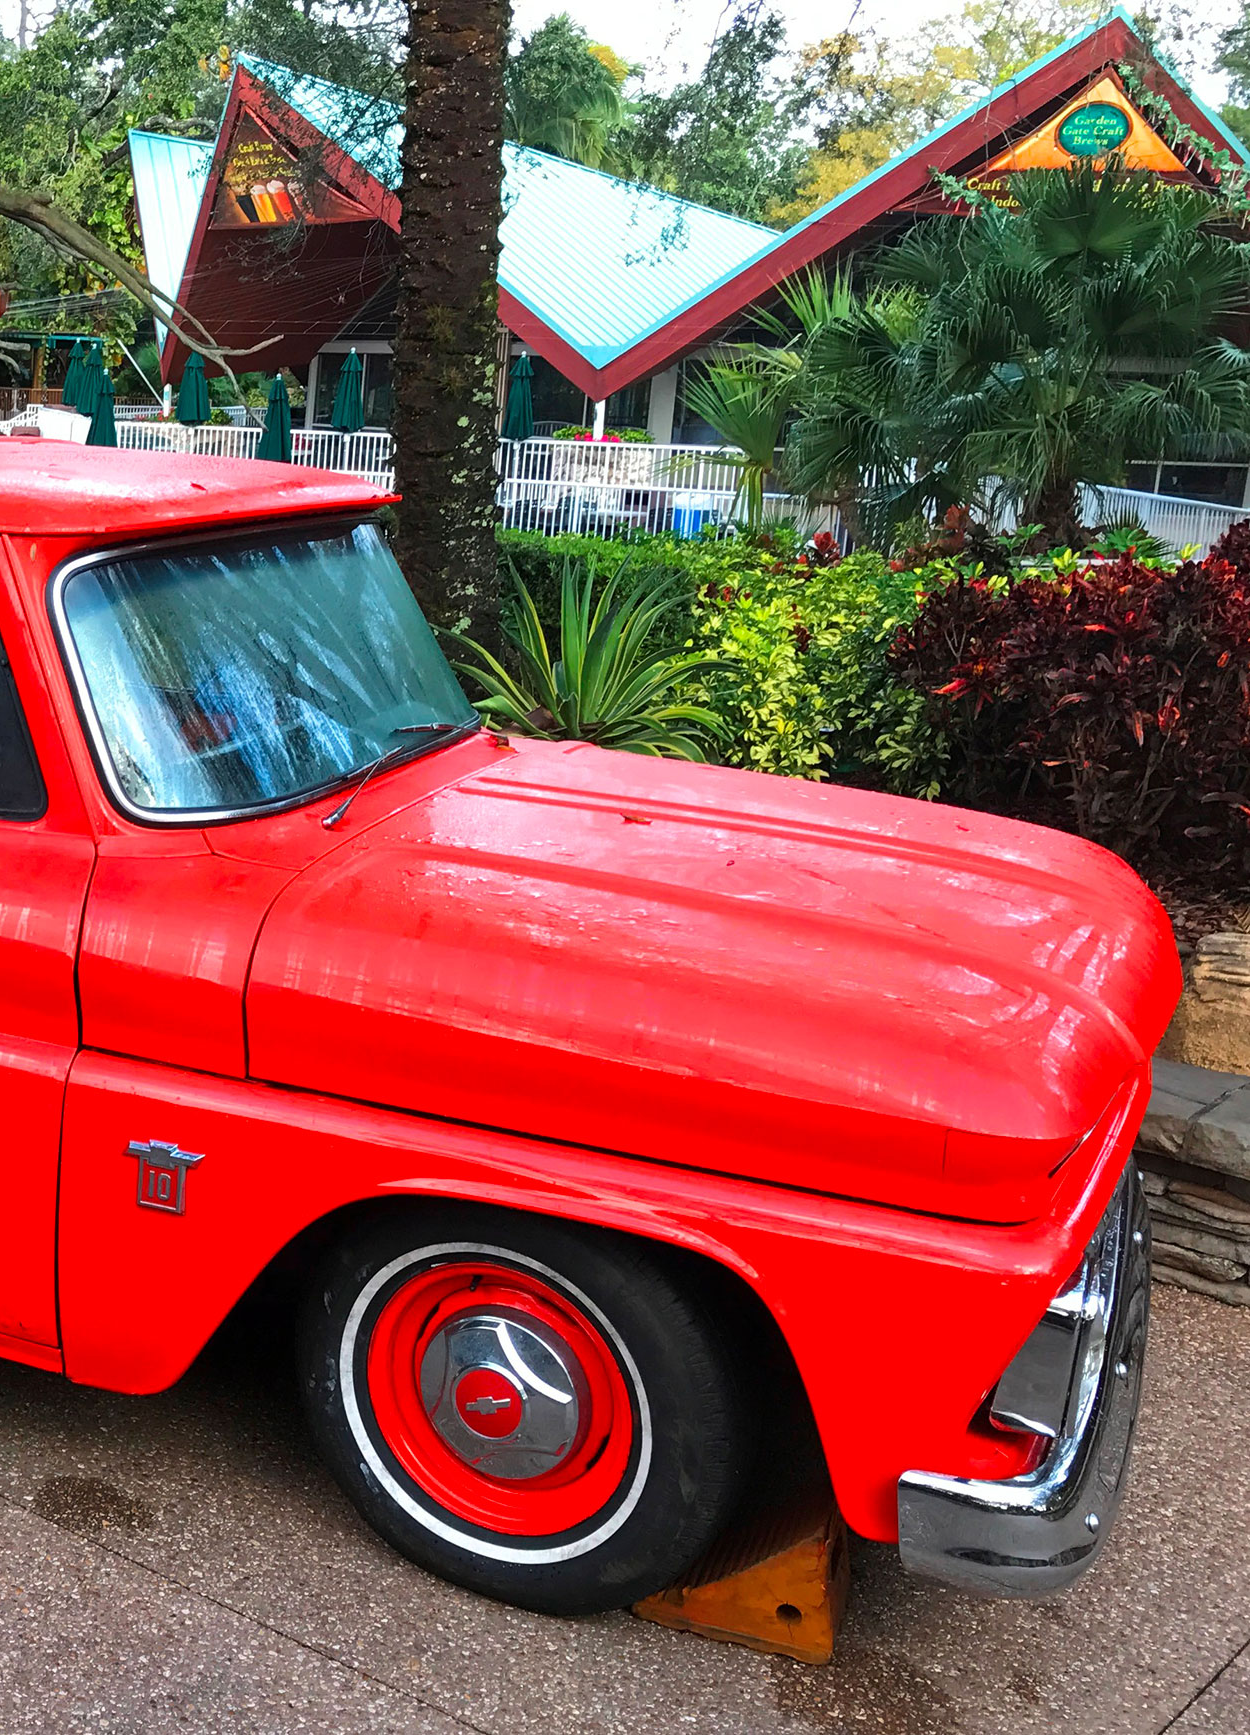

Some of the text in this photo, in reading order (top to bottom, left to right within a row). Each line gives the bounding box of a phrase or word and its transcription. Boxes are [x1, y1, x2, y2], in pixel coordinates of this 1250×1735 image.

[1074, 115, 1117, 125] Garden
[1062, 125, 1124, 136] Gate Craft
[1072, 135, 1109, 145] Brews
[967, 178, 1001, 191] Craft
[148, 1170, 171, 1201] 10
